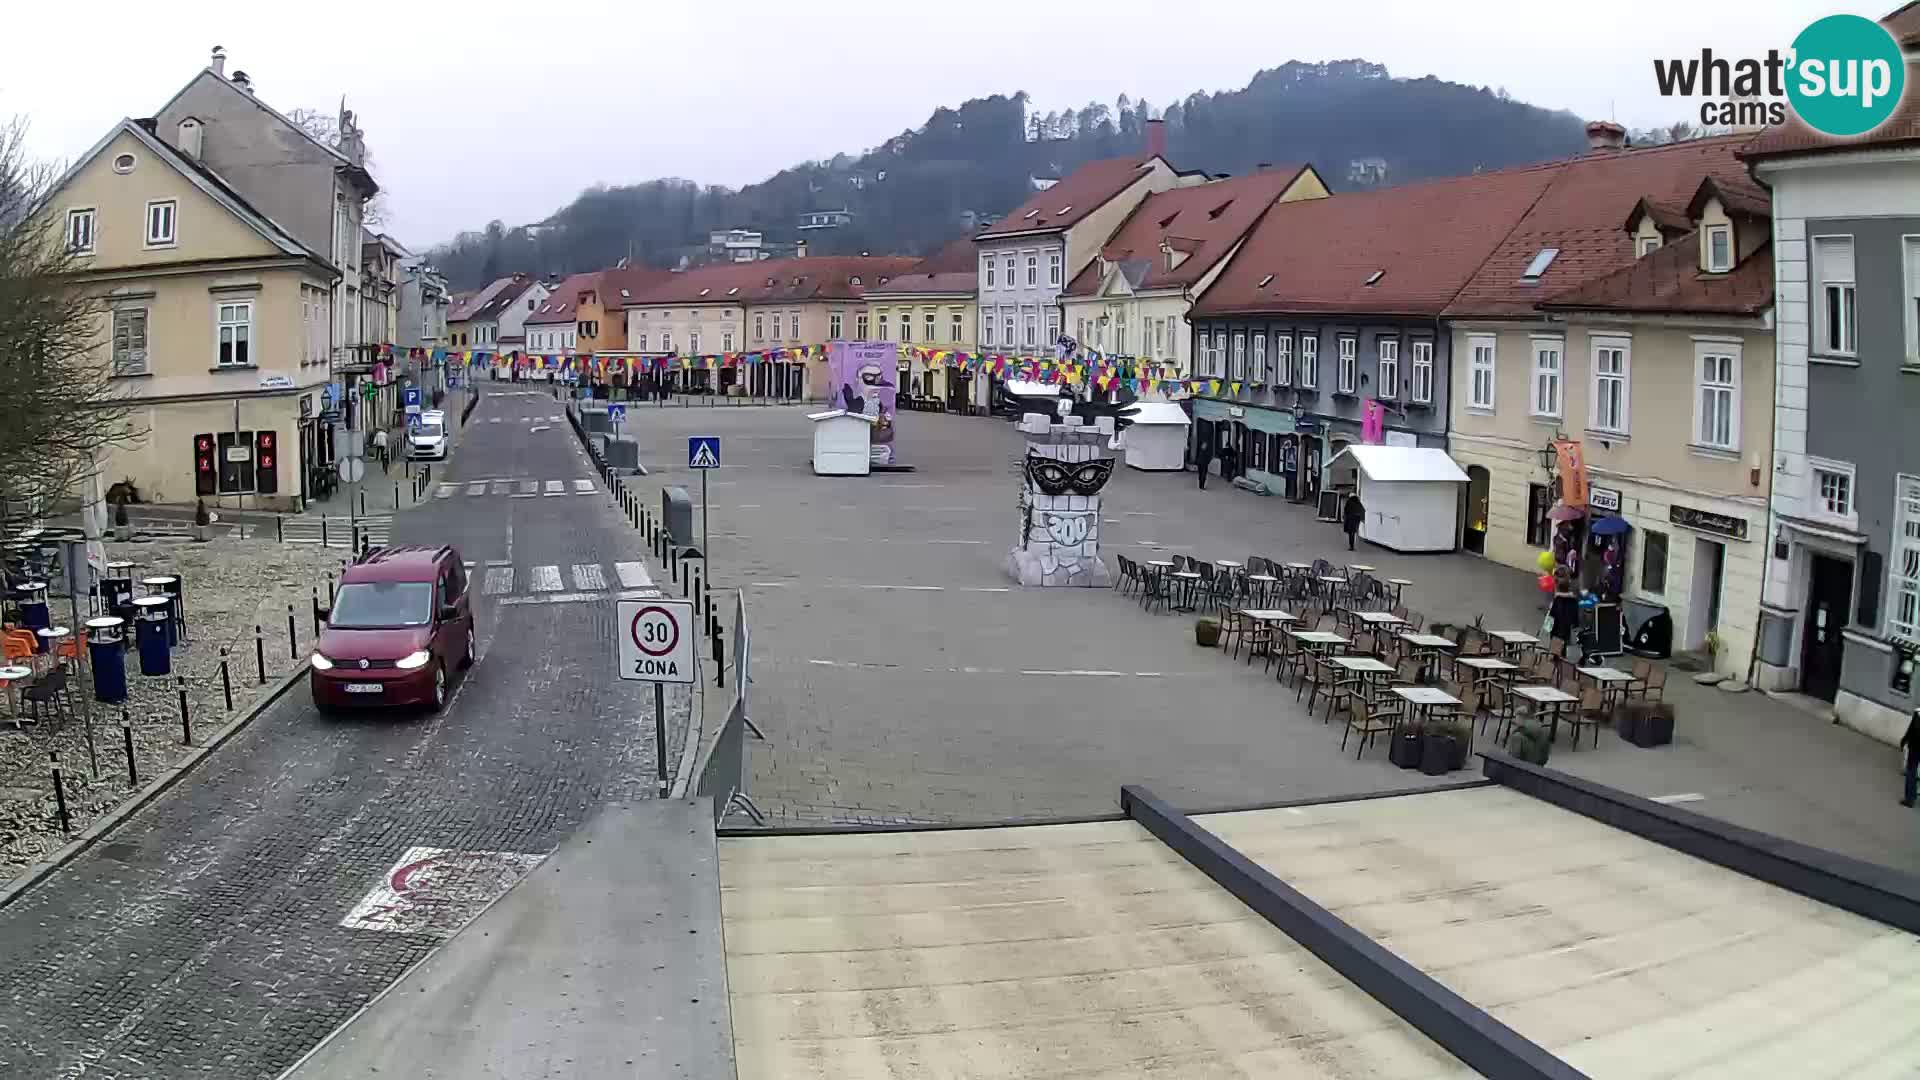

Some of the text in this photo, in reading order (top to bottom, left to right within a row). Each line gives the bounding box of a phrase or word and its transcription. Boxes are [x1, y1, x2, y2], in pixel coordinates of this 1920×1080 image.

[408, 392, 416, 403] P
[1048, 516, 1087, 546] 200
[644, 622, 668, 643] 30
[635, 659, 678, 676] ZONA
